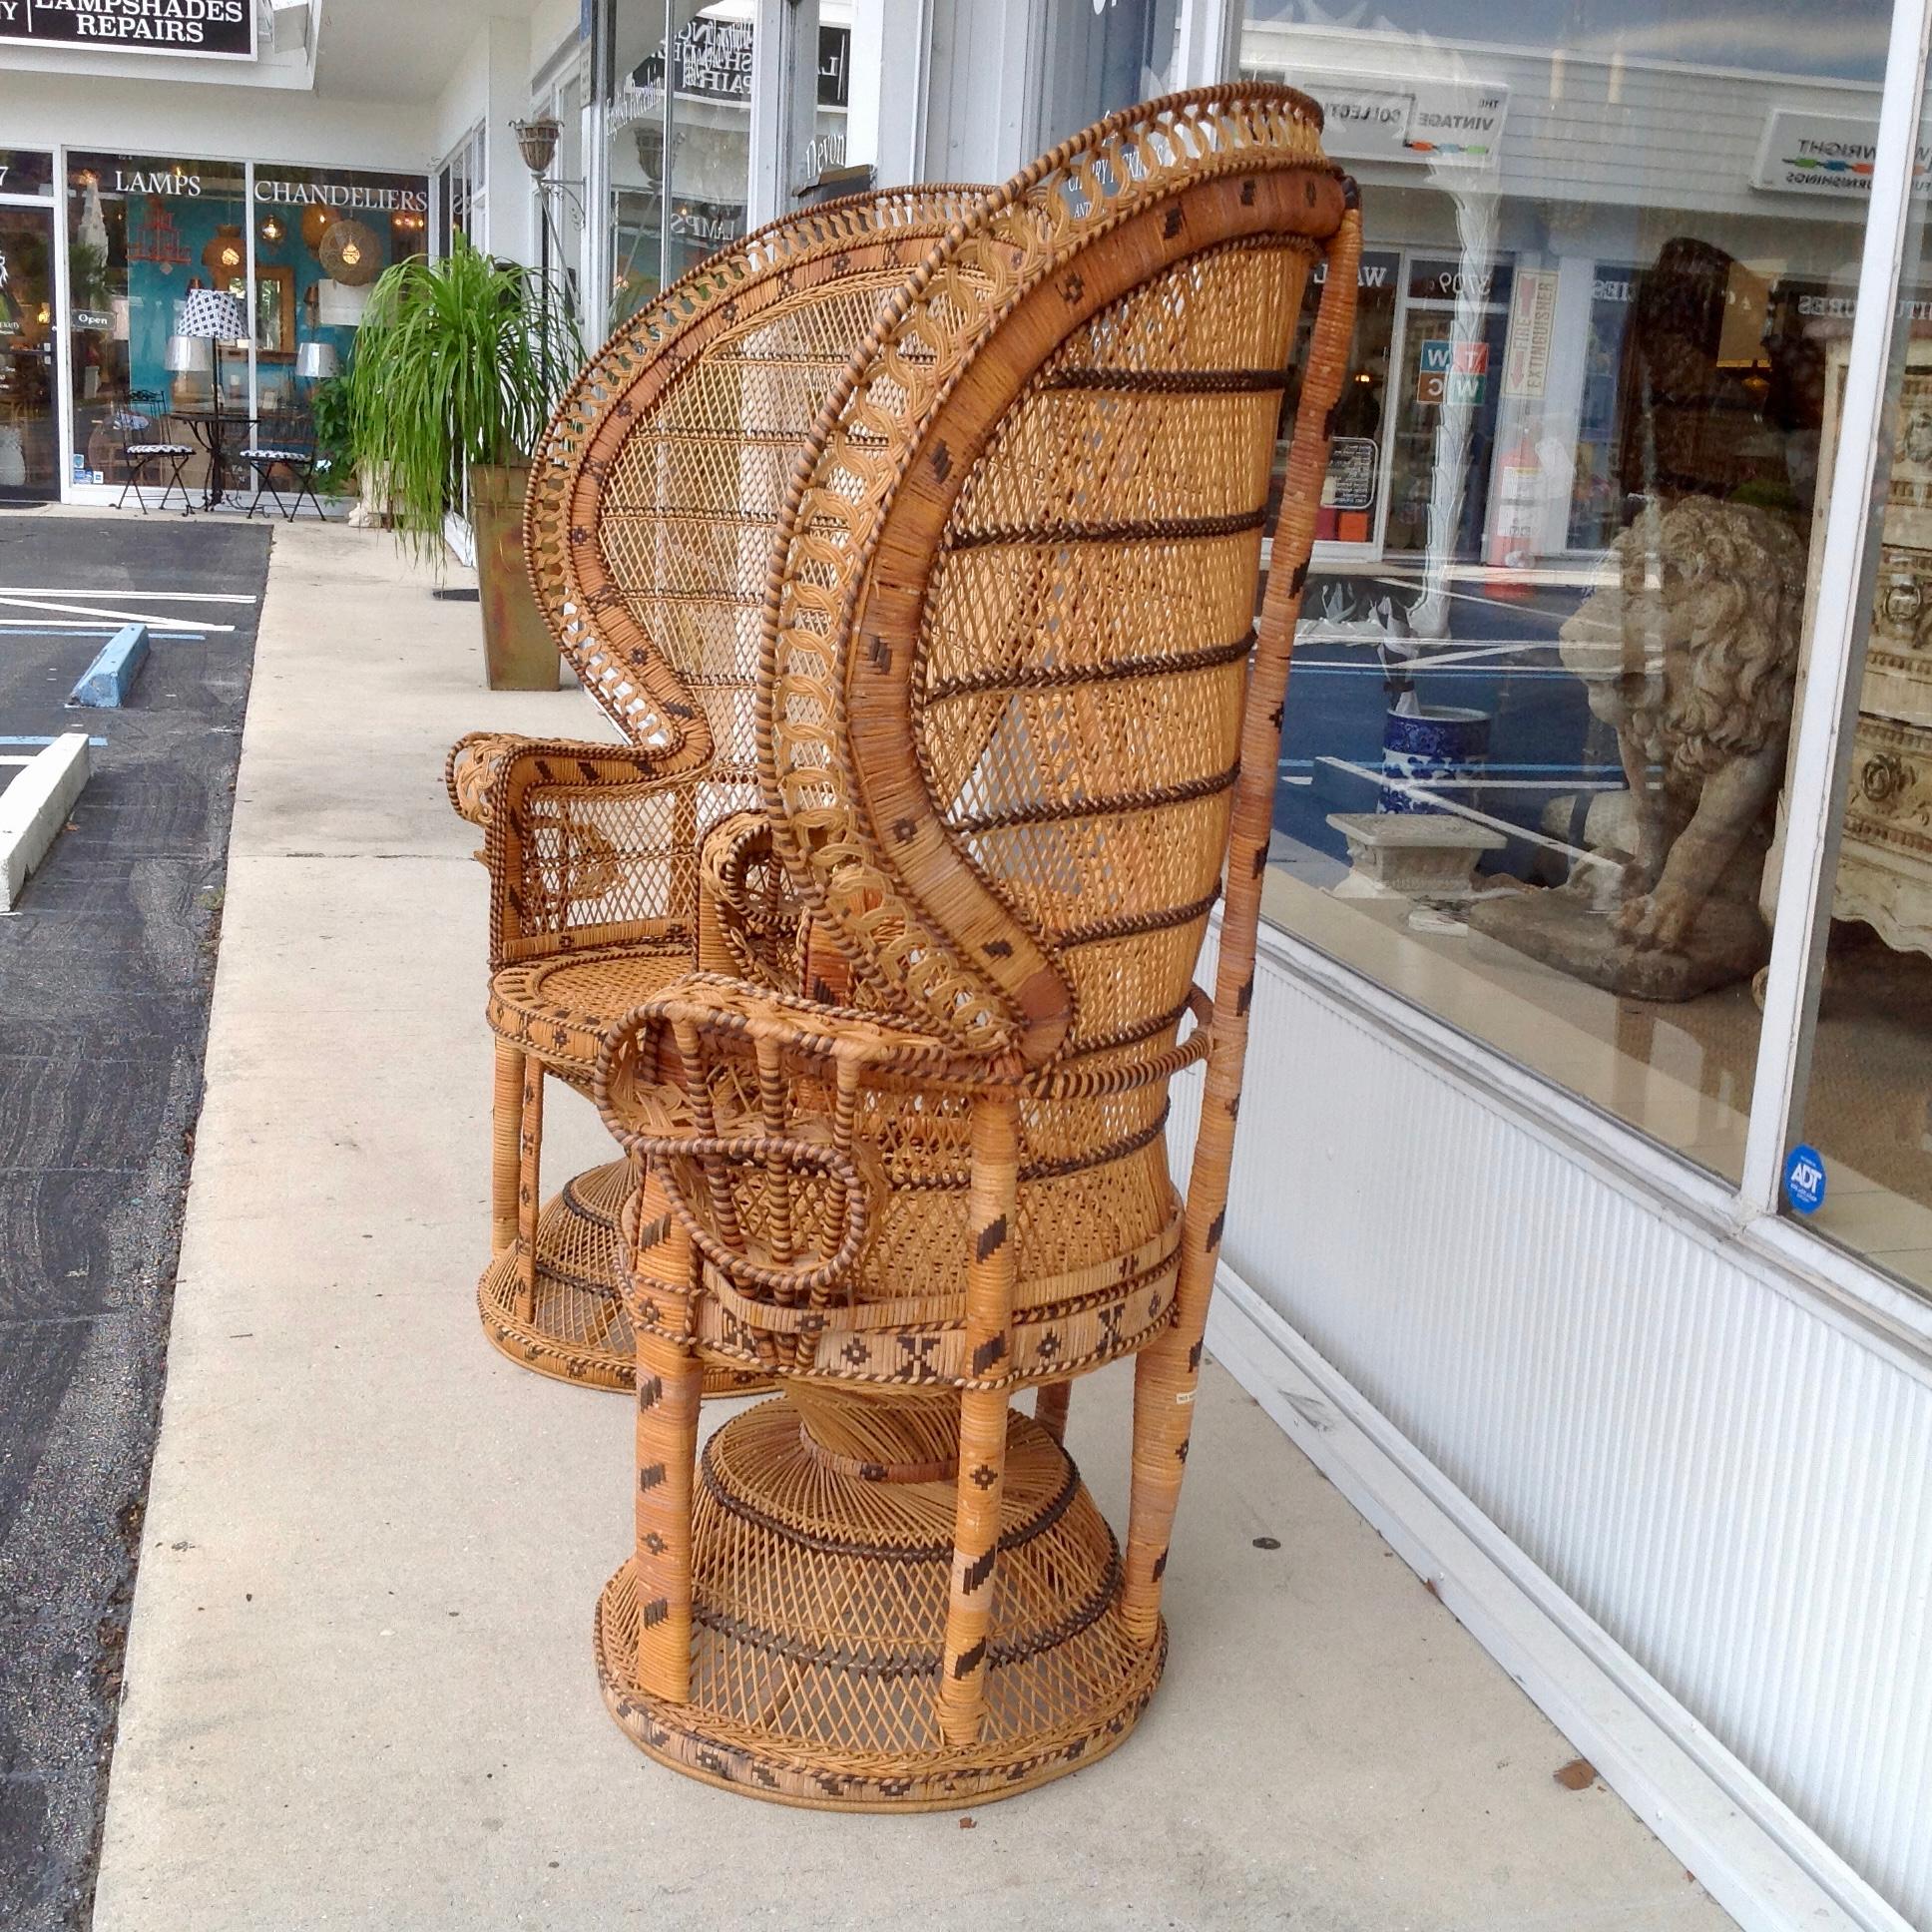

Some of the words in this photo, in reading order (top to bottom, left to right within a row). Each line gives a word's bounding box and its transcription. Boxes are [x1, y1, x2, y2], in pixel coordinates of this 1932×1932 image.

[76, 14, 205, 43] REPAIRS
[115, 170, 202, 197] LAMPS
[254, 180, 428, 213] CHANDELIERS
[78, 313, 108, 325] Open
[1790, 1163, 1822, 1194] ADT
